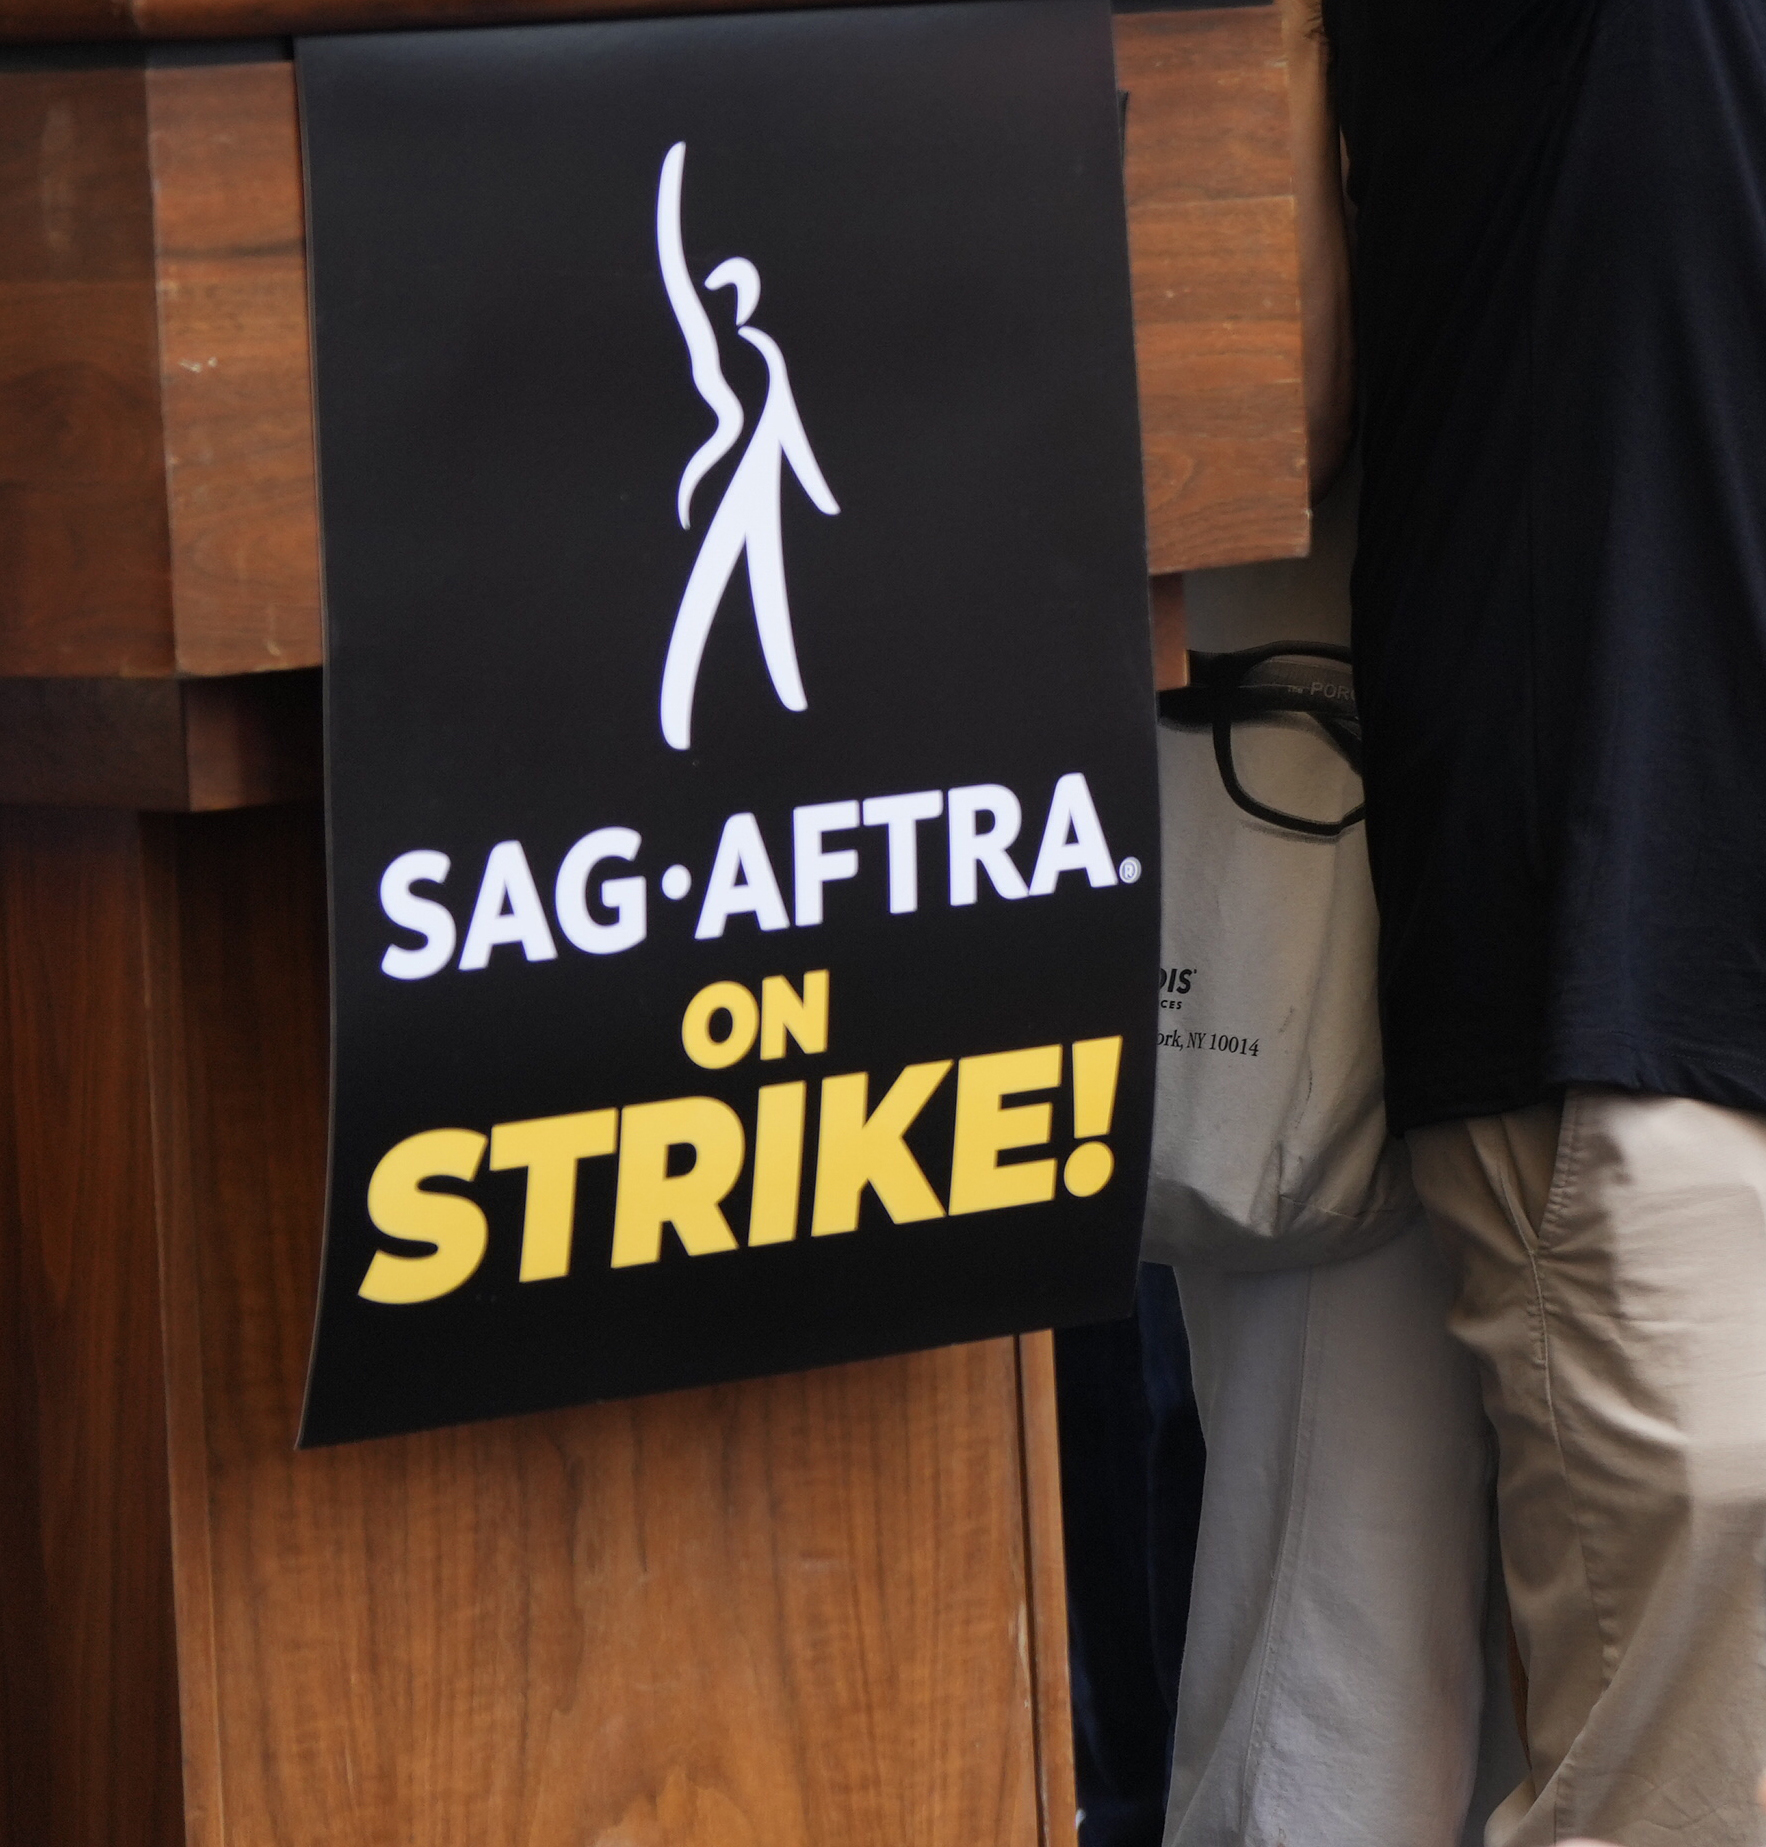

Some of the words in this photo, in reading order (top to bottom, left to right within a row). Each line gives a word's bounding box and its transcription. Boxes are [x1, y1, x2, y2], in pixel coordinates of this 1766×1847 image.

[682, 969, 829, 1070] ON
[1158, 1029, 1184, 1052] ork,
[1187, 1032, 1207, 1049] NY
[1209, 1033, 1260, 1057] 10014
[358, 1036, 1123, 1305] STRIKE!
